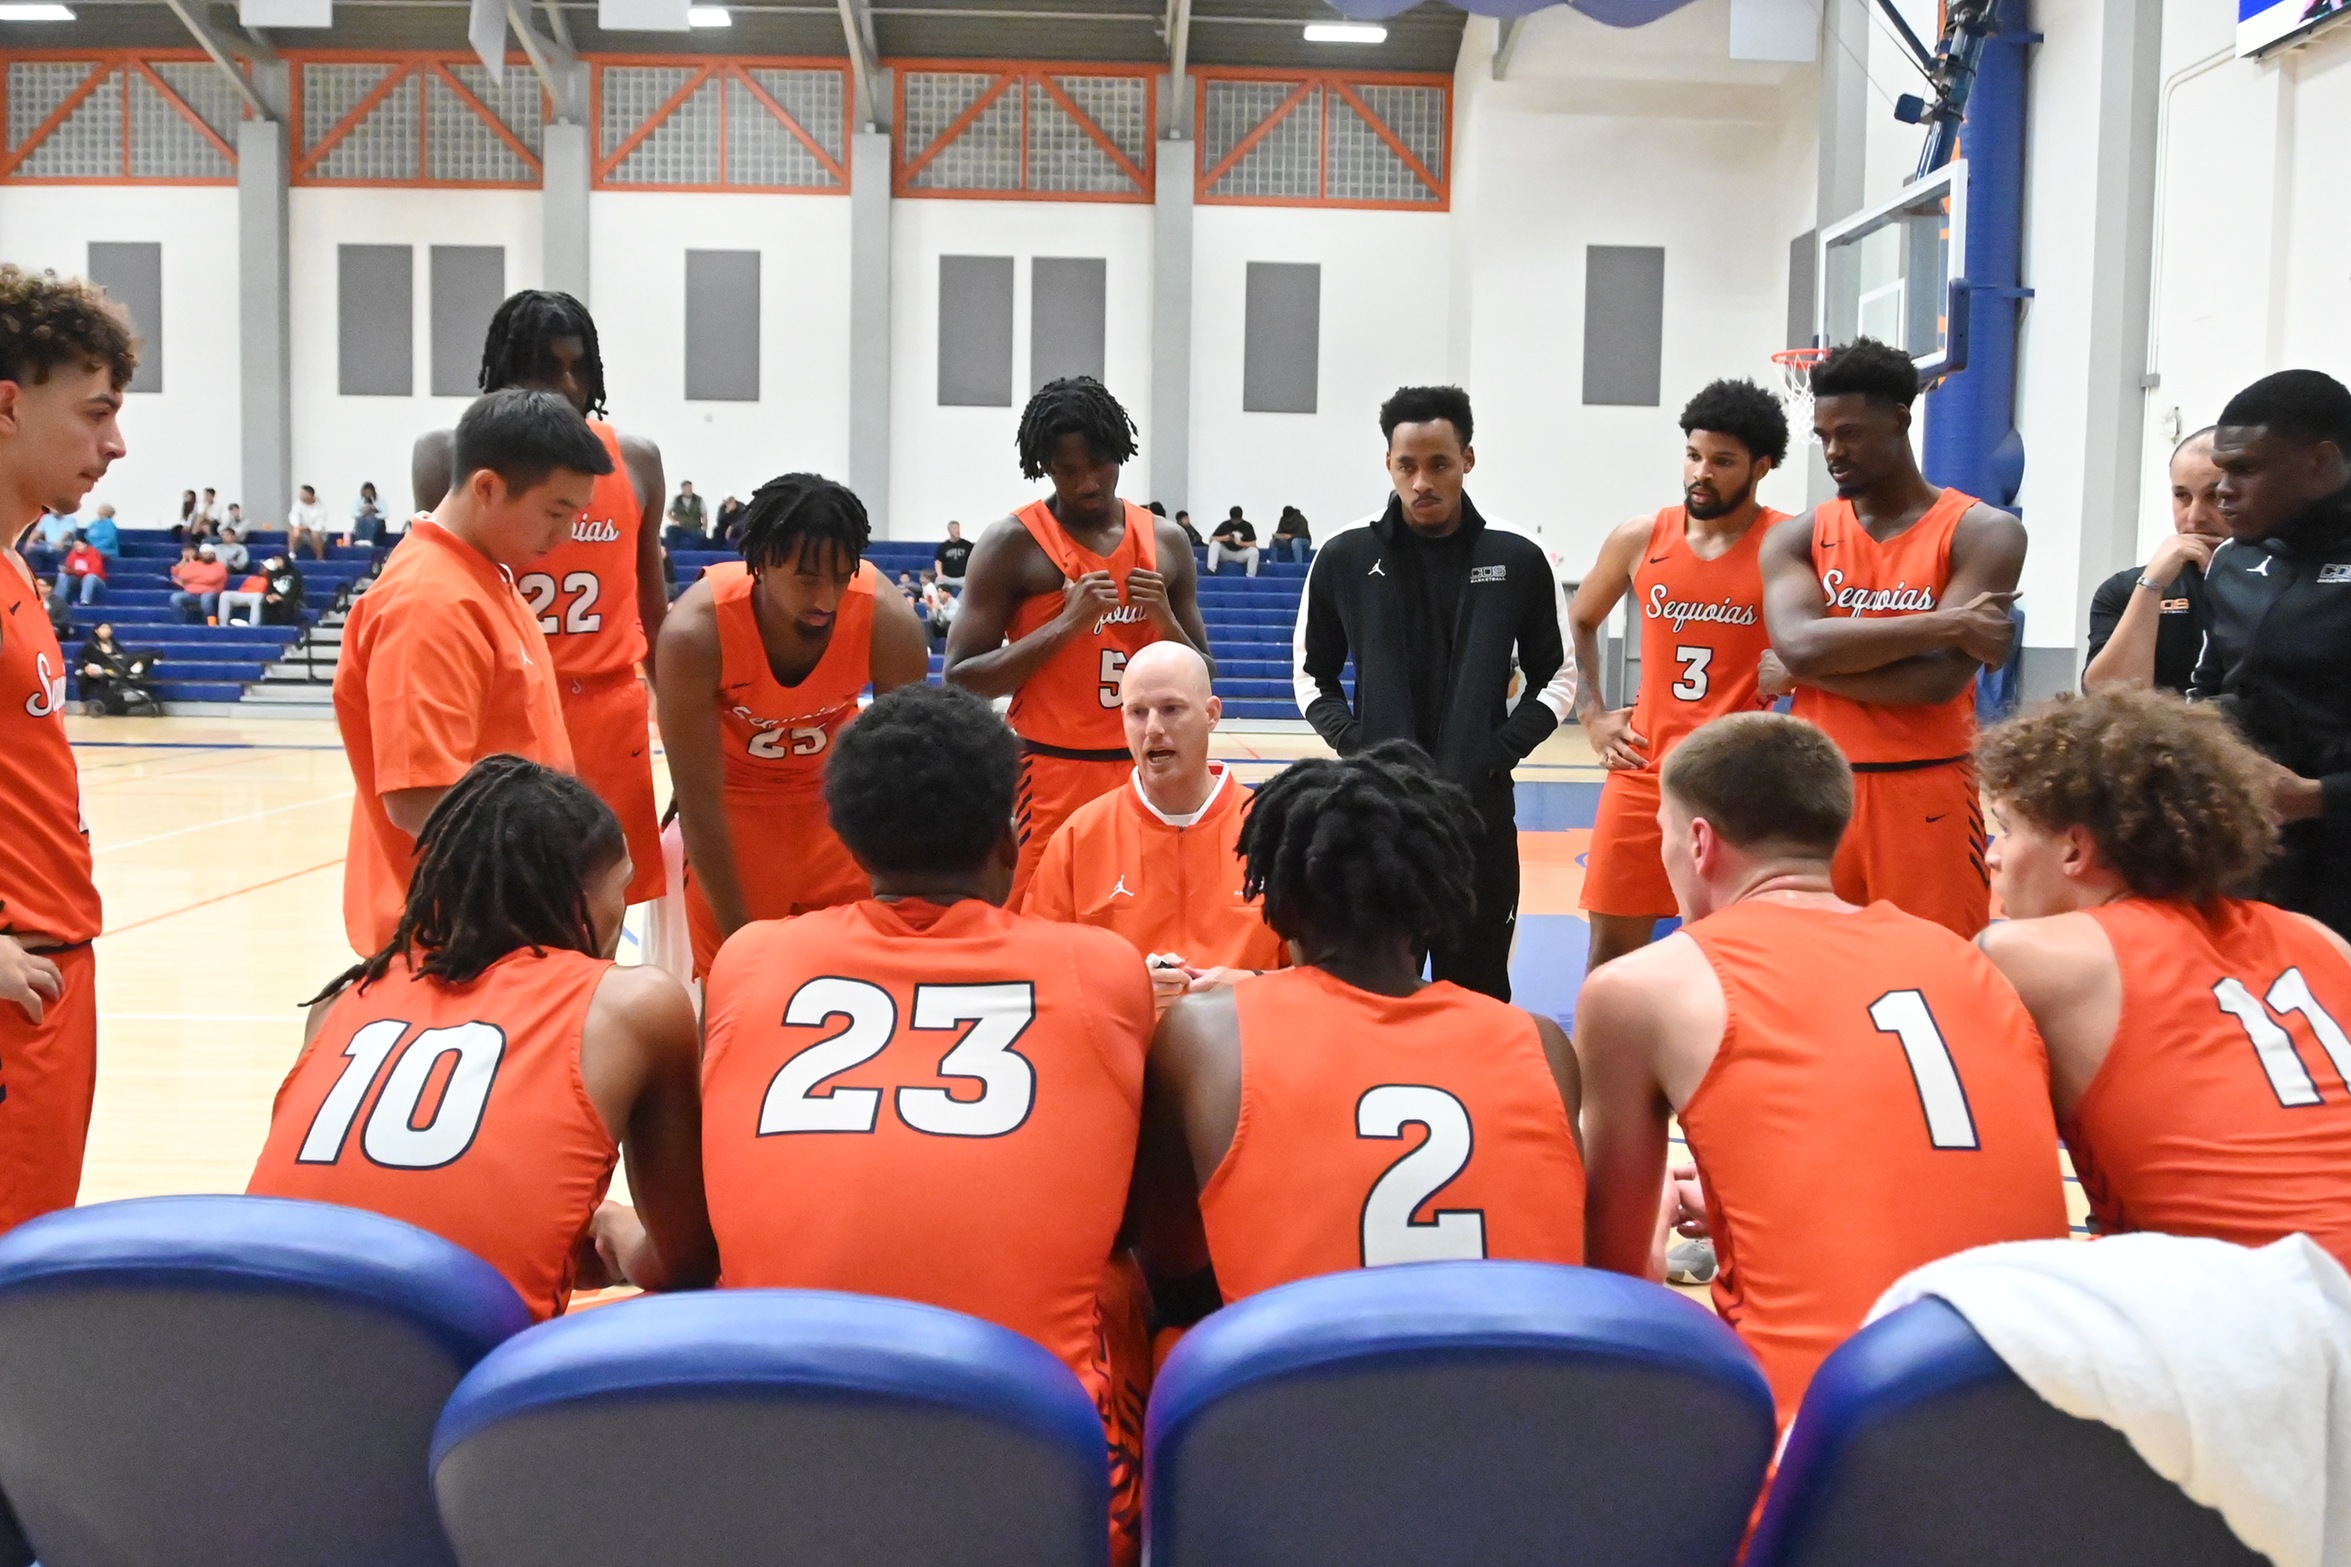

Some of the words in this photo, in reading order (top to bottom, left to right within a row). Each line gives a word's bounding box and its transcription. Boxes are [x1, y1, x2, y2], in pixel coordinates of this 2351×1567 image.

[518, 570, 602, 636] 22
[1645, 583, 1758, 633] Sequoias
[1671, 644, 1714, 702] 3
[1098, 648, 1128, 709] 5
[295, 1018, 505, 1170] 10
[756, 976, 1037, 1138] 23
[1866, 988, 1981, 1152] 1
[2211, 966, 2351, 1109] 11
[1355, 1083, 1489, 1267] 2
